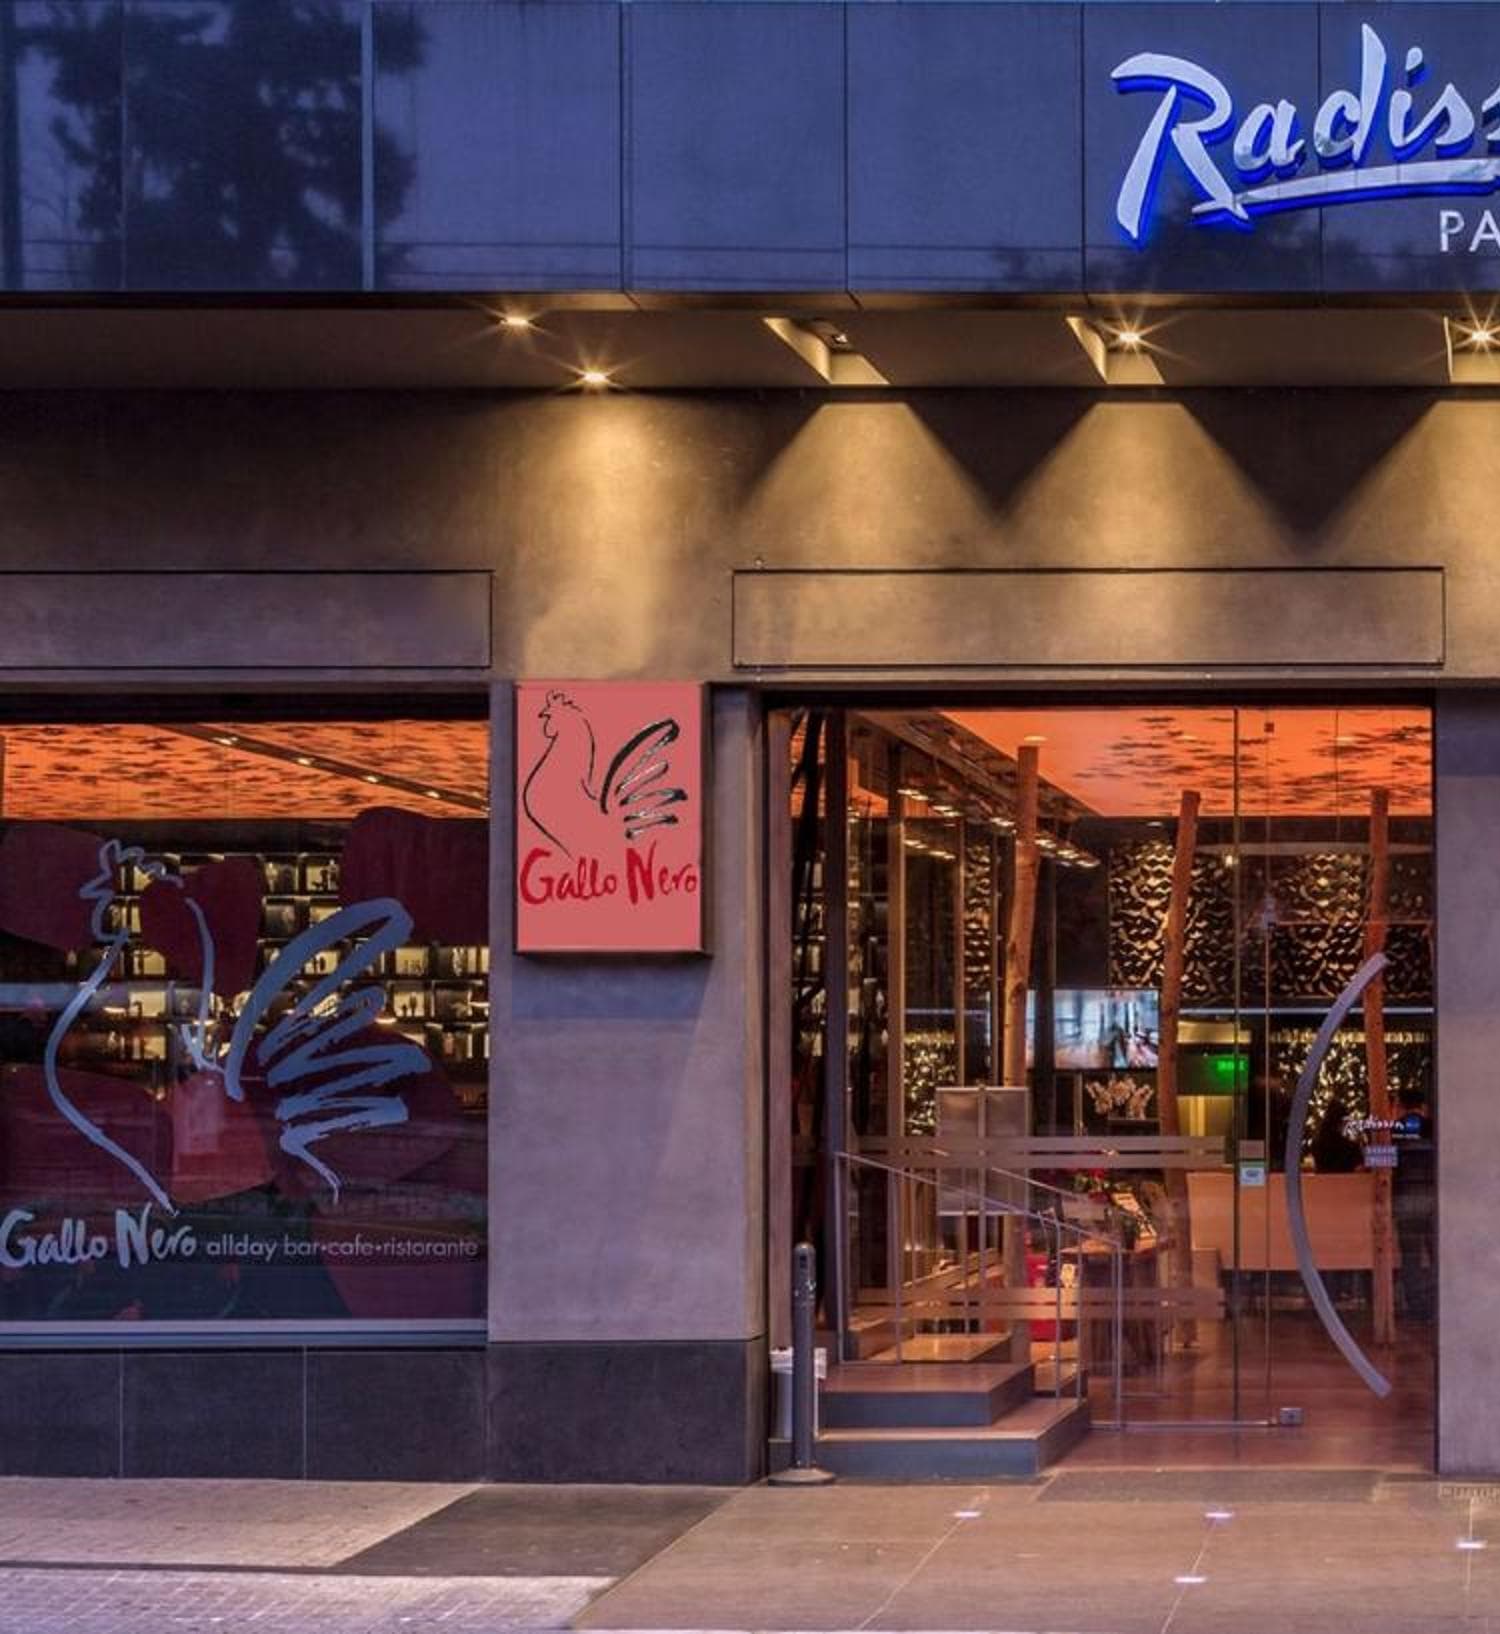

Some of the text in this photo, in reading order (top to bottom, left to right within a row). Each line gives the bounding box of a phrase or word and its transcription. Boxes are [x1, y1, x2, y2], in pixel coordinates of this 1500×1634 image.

[520, 840, 698, 905] Gallo Nero
[0, 1209, 108, 1268] Gallo
[115, 1202, 197, 1269] Nero
[206, 1234, 278, 1261] allday
